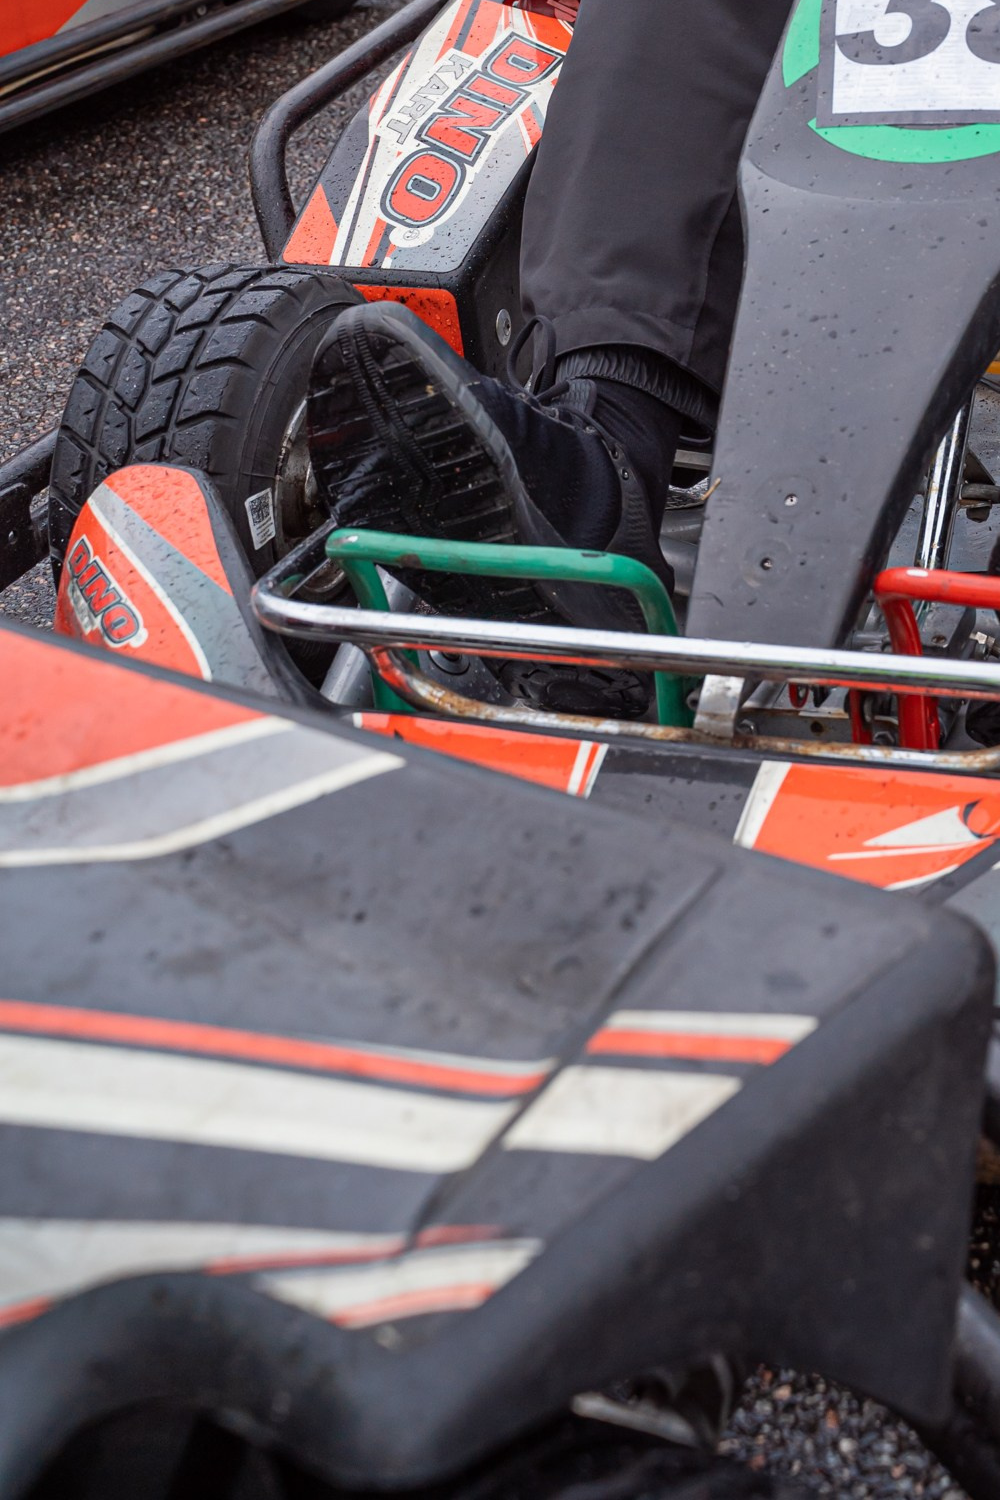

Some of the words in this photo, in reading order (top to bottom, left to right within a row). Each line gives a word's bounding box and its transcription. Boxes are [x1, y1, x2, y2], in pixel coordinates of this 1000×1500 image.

[380, 30, 566, 229] DINO
[386, 53, 474, 146] KART
[68, 538, 140, 645] DINO
